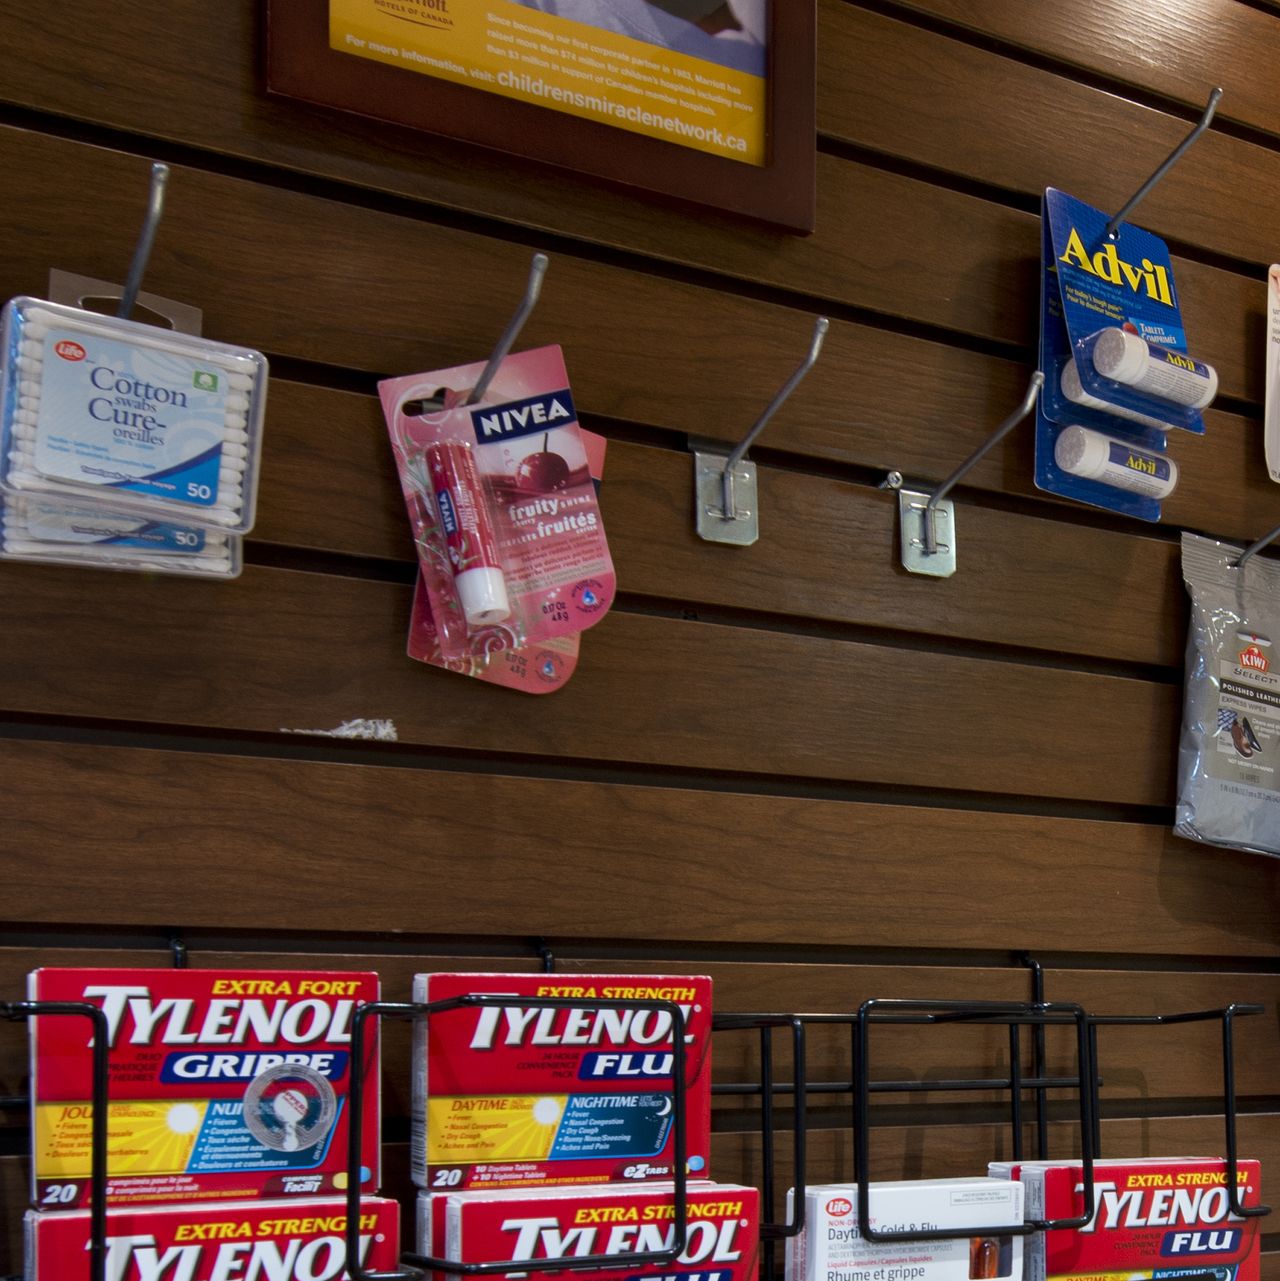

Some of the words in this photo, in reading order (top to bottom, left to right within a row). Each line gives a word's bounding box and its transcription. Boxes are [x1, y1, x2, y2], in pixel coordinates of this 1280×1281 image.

[345, 34, 365, 48] For
[368, 43, 399, 57] more
[401, 48, 468, 77] information,
[497, 70, 748, 153] childrensmiraclenetwork.ca
[1058, 226, 1175, 308] Advil
[1166, 351, 1196, 373] Advil
[90, 366, 188, 408] Cotton
[88, 398, 167, 432] Cure-
[114, 395, 157, 414] swabs
[480, 398, 570, 437] NIVEA
[113, 425, 165, 446] oreilles
[1126, 453, 1157, 476] Advil
[187, 482, 211, 499] 50
[437, 491, 456, 534] NIVEA
[507, 497, 559, 522] fruity
[536, 510, 598, 539] fruités
[175, 532, 198, 547] 50
[1241, 653, 1267, 671] KIWI
[1234, 668, 1276, 684] SELECT
[1223, 683, 1254, 697] POLISHED
[212, 979, 293, 995] EXTRA
[296, 980, 361, 996] FORT
[537, 986, 597, 999] EXTRA
[602, 987, 696, 1000] STRENGTH
[82, 985, 354, 1049] TYLENOL
[470, 992, 696, 1050] TYLENOL
[172, 1053, 335, 1079] GRIPPE
[592, 1053, 673, 1076] FLU
[451, 1099, 507, 1112] DAYTIME
[571, 1095, 639, 1109] NIGHTTIME
[433, 1169, 462, 1188] 20
[42, 1183, 78, 1204] 20
[828, 1200, 851, 1214] Life
[1170, 1230, 1234, 1253] FLU
[873, 1269, 885, 1280] et
